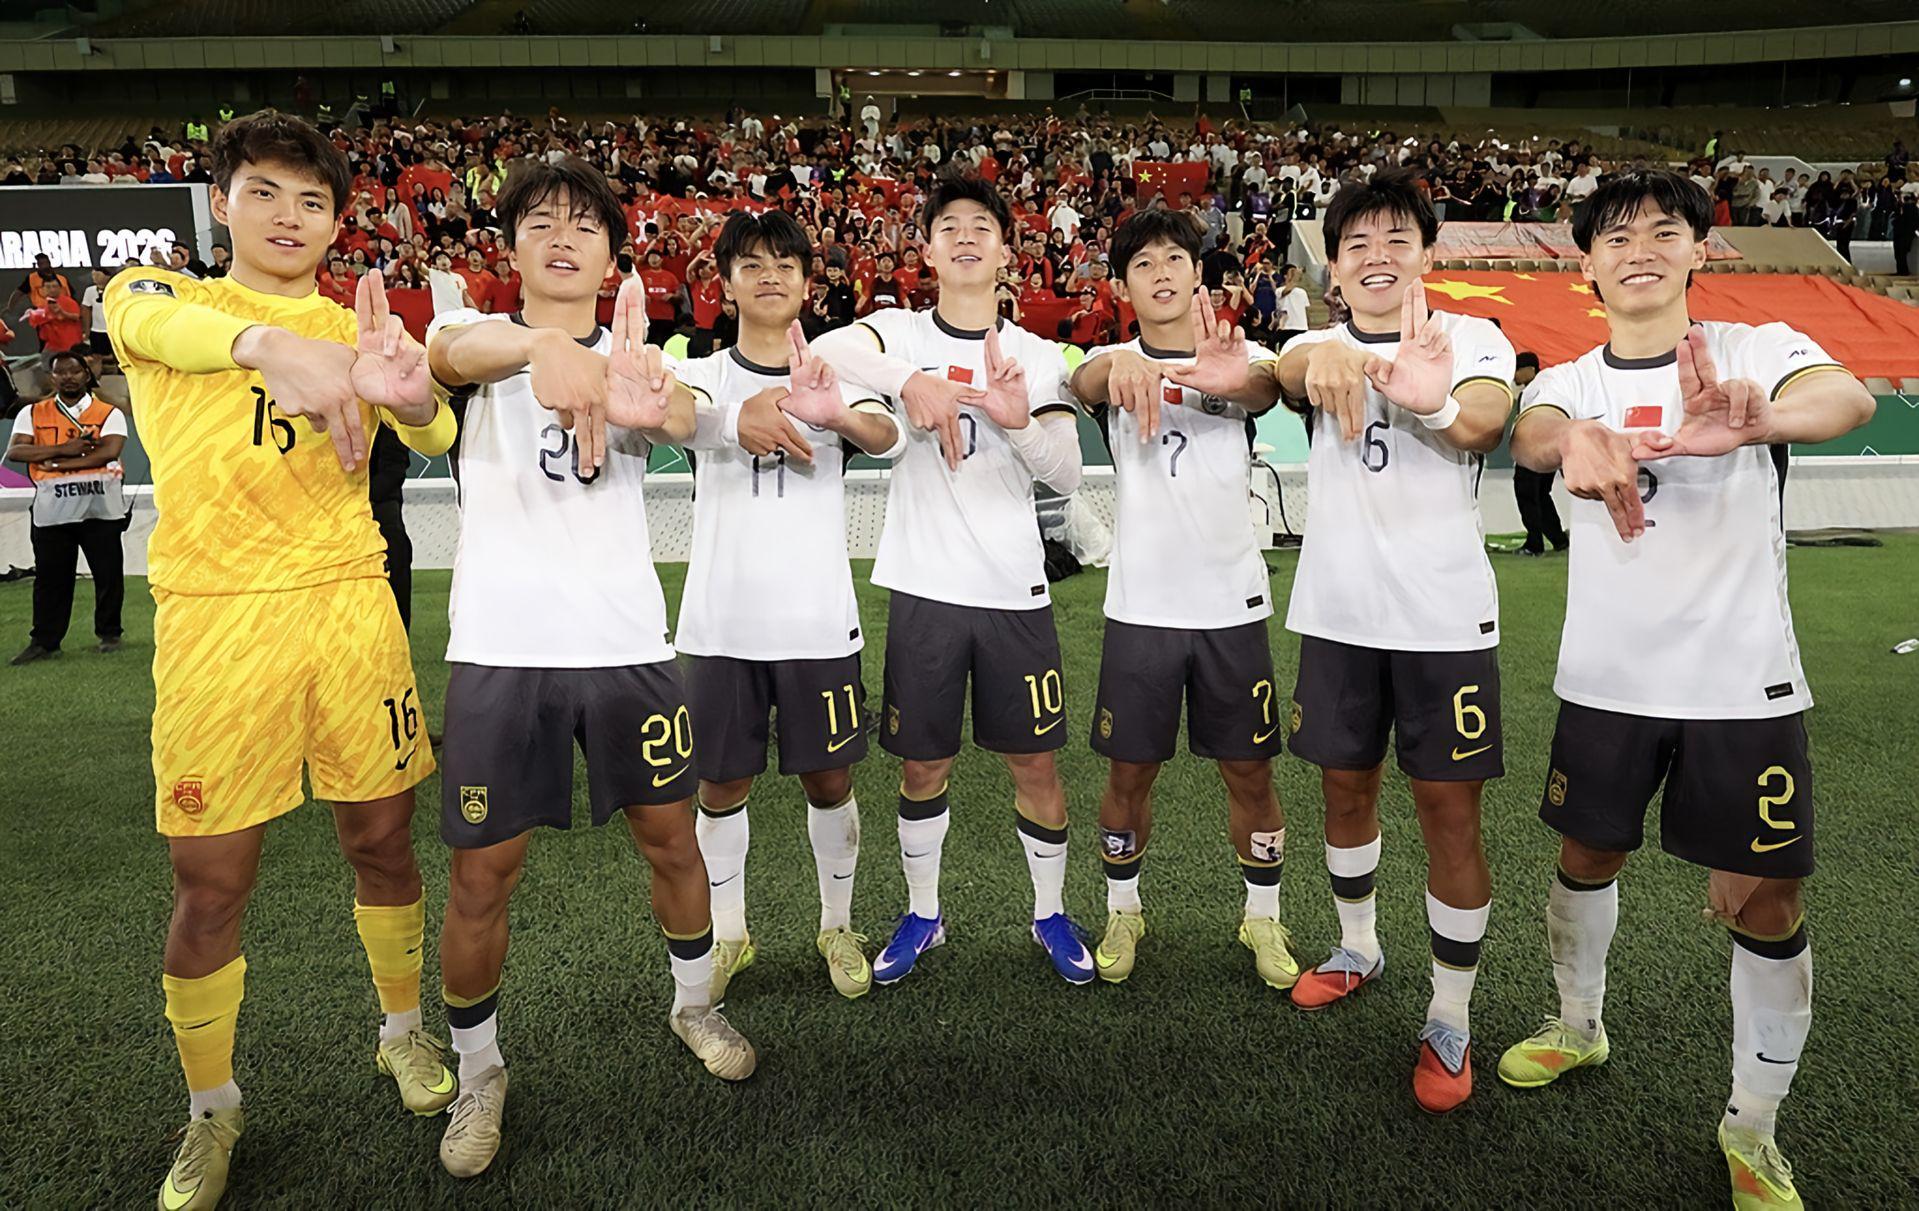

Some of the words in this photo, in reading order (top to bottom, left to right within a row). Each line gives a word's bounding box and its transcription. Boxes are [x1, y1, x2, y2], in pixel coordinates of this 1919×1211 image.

[0, 230, 93, 268] RABIA
[97, 228, 176, 267] 2026
[250, 386, 296, 455] 16
[1362, 420, 1390, 472] 6
[1162, 430, 1187, 477] 7
[383, 687, 418, 751] 16
[821, 684, 859, 735] 11
[1024, 669, 1063, 718] 10
[1252, 679, 1272, 724] 7
[1453, 684, 1486, 739] 6
[641, 704, 693, 767] 20
[1757, 765, 1795, 829] 2
